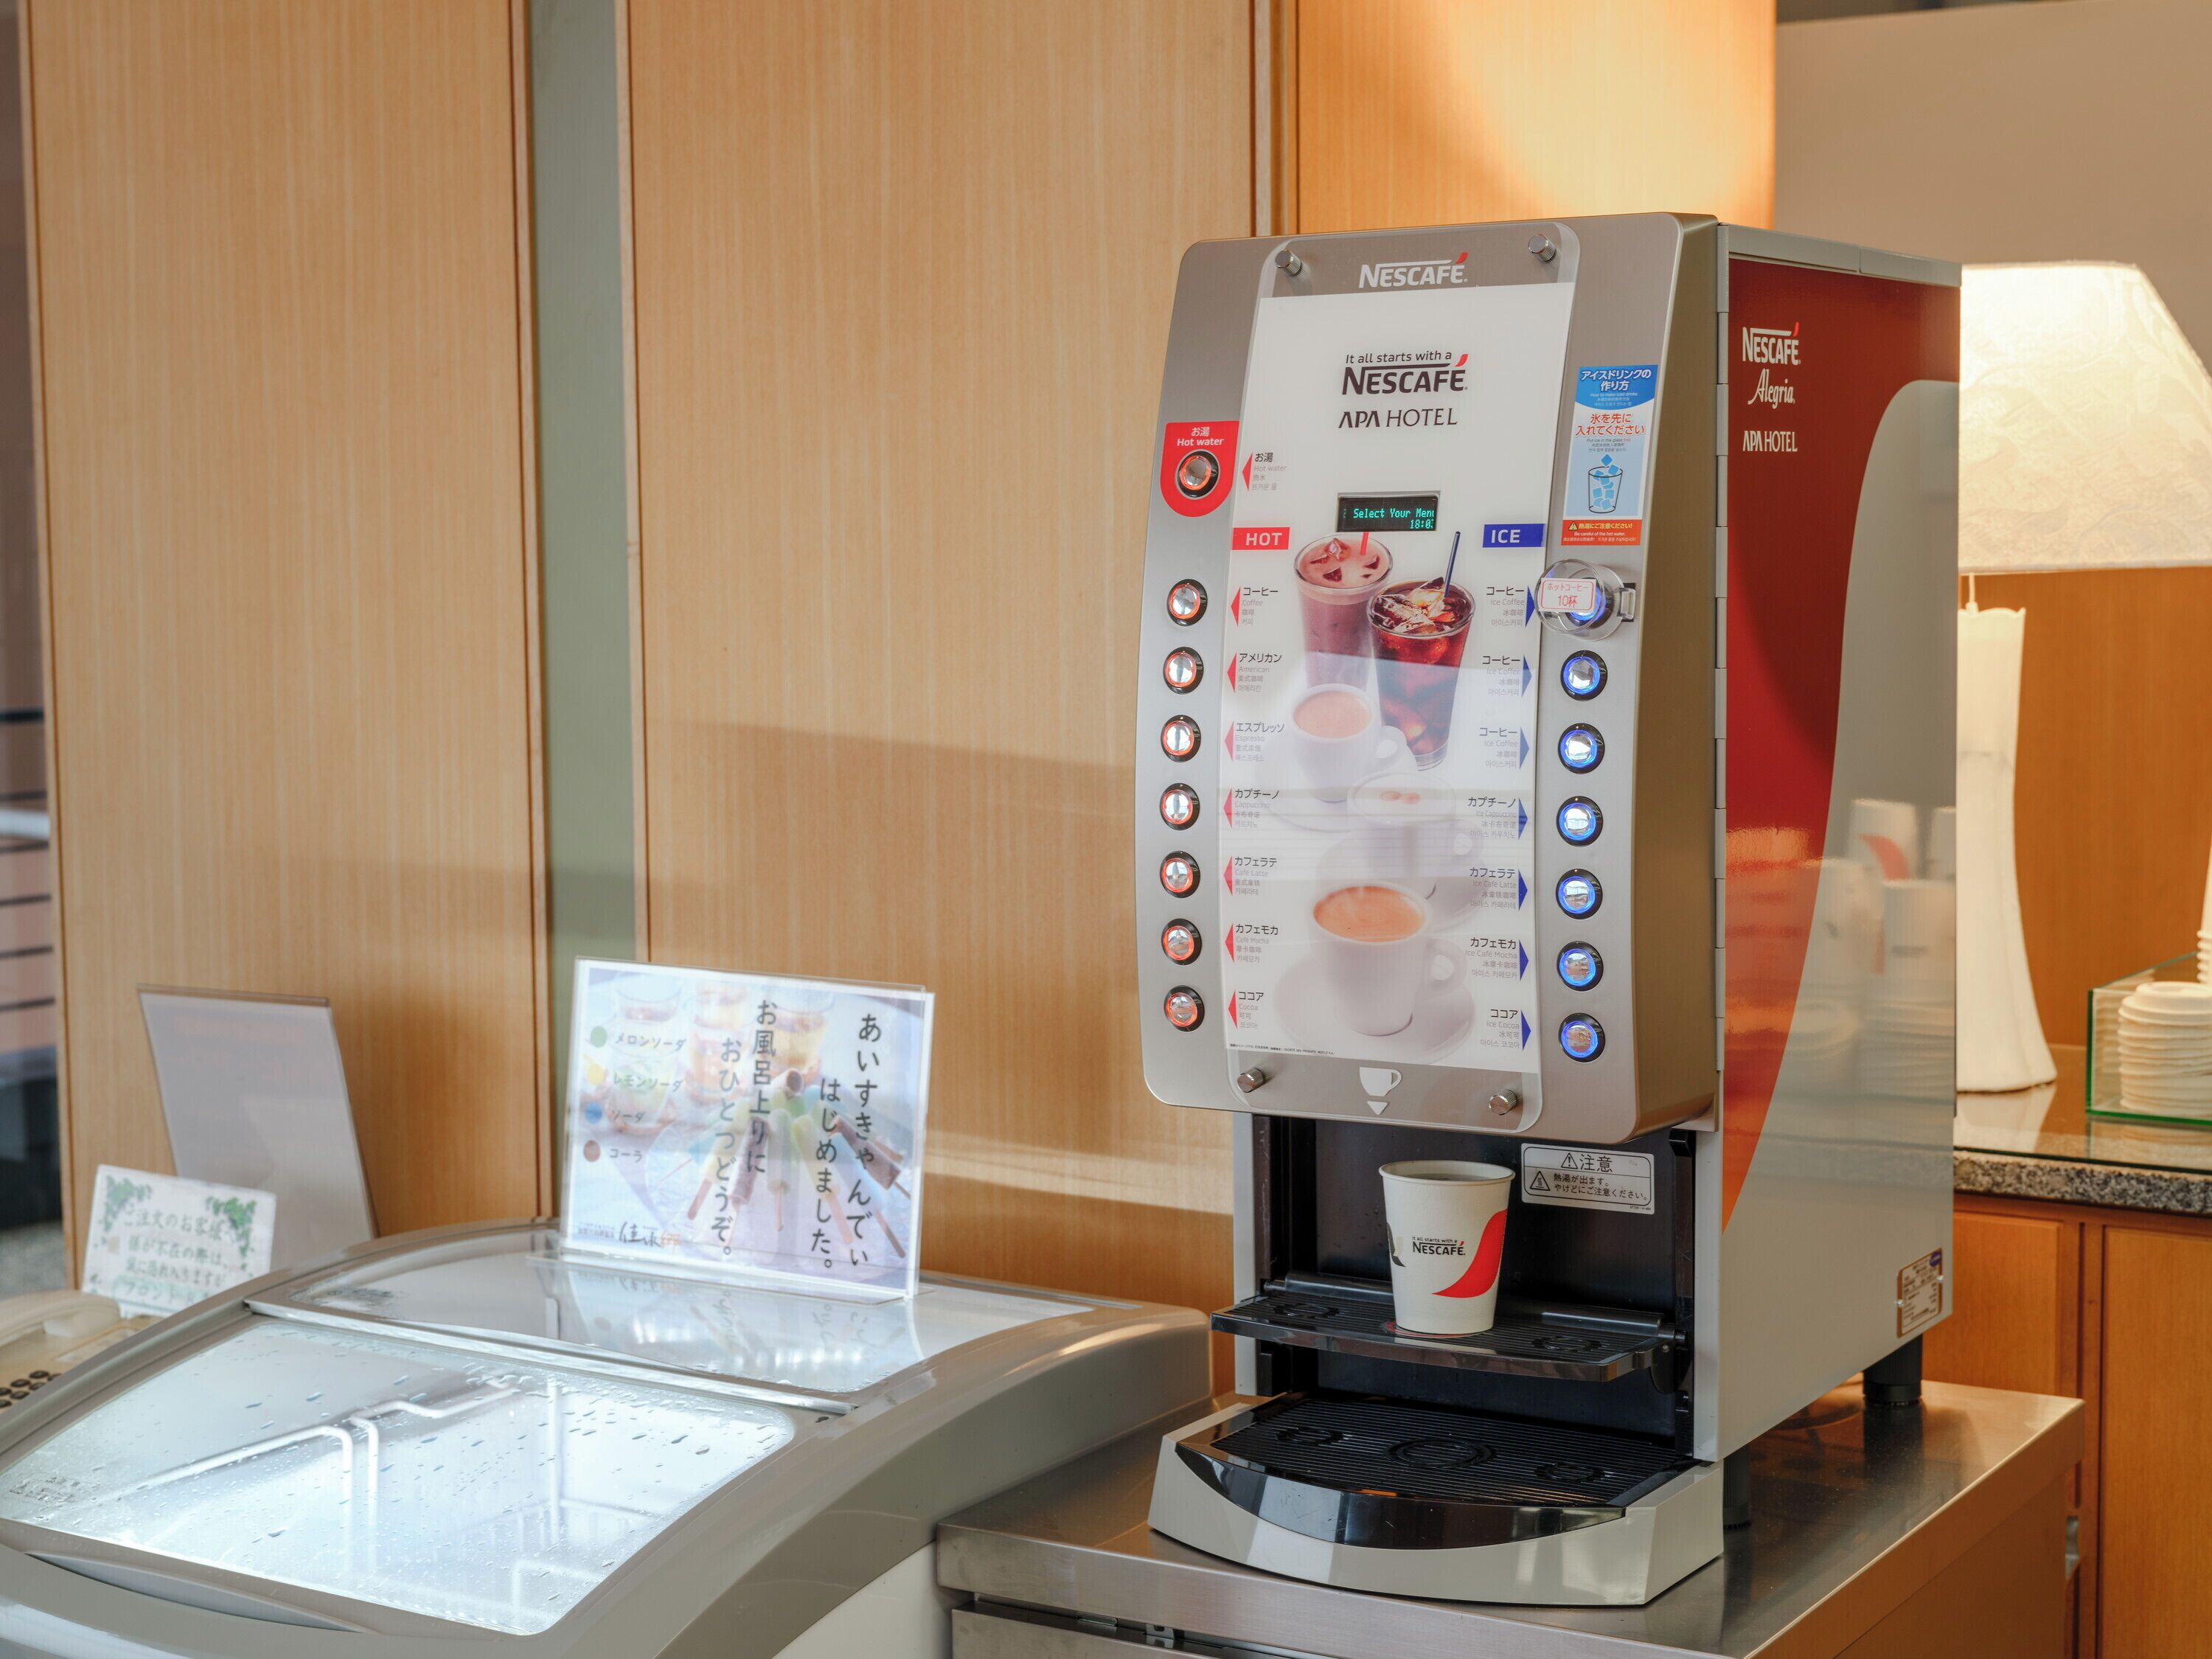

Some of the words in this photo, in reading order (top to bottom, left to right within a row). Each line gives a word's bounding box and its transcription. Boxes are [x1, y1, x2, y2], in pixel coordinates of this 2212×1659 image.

[1358, 252, 1468, 288] NESCAFÉ
[1742, 321, 1801, 366] NESCAFÉ
[1346, 355, 1354, 364] It
[1357, 352, 1373, 364] all
[1376, 352, 1412, 363] starts
[1415, 350, 1441, 361] with
[1445, 352, 1453, 361] a
[1341, 354, 1468, 395] NESCAFÉ
[1581, 369, 1652, 380] アイスドリンクの
[1600, 380, 1630, 392] 作り方
[1747, 368, 1795, 409] Alegria
[1338, 411, 1381, 429] APA
[1386, 408, 1458, 428] HOTEL
[1590, 413, 1632, 425] 氷を先に
[1191, 426, 1210, 437] お湯
[1575, 425, 1645, 437] 入れてください
[1742, 430, 1763, 452] APA
[1764, 431, 1798, 452] HOTEL
[1254, 452, 1273, 462] お湯
[1353, 508, 1385, 518] Select
[1390, 508, 1411, 518] Your
[1245, 532, 1282, 546] HOT
[1492, 529, 1520, 543] ICE
[1243, 587, 1279, 596] コーヒー
[1486, 586, 1524, 596] コーヒー
[1547, 582, 1588, 592] ホットコーヒー
[1558, 595, 1578, 608] 10杯
[1239, 653, 1282, 663] アメリカン
[1482, 655, 1520, 665] コーヒー
[1498, 667, 1520, 675] Coffee
[1236, 722, 1285, 733] エスプレッソ
[1479, 727, 1517, 737] コーヒー
[1235, 735, 1265, 743] Espresso
[1495, 740, 1518, 748] Coffee
[1234, 788, 1279, 799] カプチーノ
[1234, 801, 1270, 810] Cappuccino
[1467, 796, 1516, 808] カプチーノ
[1485, 810, 1517, 818] Cappuccino
[1234, 856, 1277, 868] カフェラテ
[1251, 869, 1269, 877] Latte
[1470, 867, 1516, 879] カフェラテ
[1483, 880, 1498, 888] Café
[1499, 881, 1517, 889] Latte
[1236, 923, 1279, 936] カフェモカ
[1470, 937, 1517, 950] カフェモカ
[1476, 950, 1492, 958] Café
[1494, 951, 1517, 959] Mocha
[1239, 991, 1264, 1001] ココア
[1490, 1009, 1518, 1019] ココア
[1498, 1021, 1520, 1029] Cocoa
[615, 1032, 687, 1051] メロンソーダ
[613, 1073, 684, 1092] レモンソーダ
[744, 999, 778, 1175] お風呂上りに
[612, 1110, 645, 1123] ソーダ
[710, 1037, 742, 1256] おひとつどうぞ。
[609, 1148, 643, 1164] コーラ
[1579, 1153, 1613, 1173] 注意
[810, 1077, 841, 1269] はじめました。
[1553, 1173, 1609, 1187] 熱湯が出ます。
[1554, 1183, 1647, 1201] やけどにご注意ください。
[1413, 1241, 1466, 1255] NESCAFÉ
